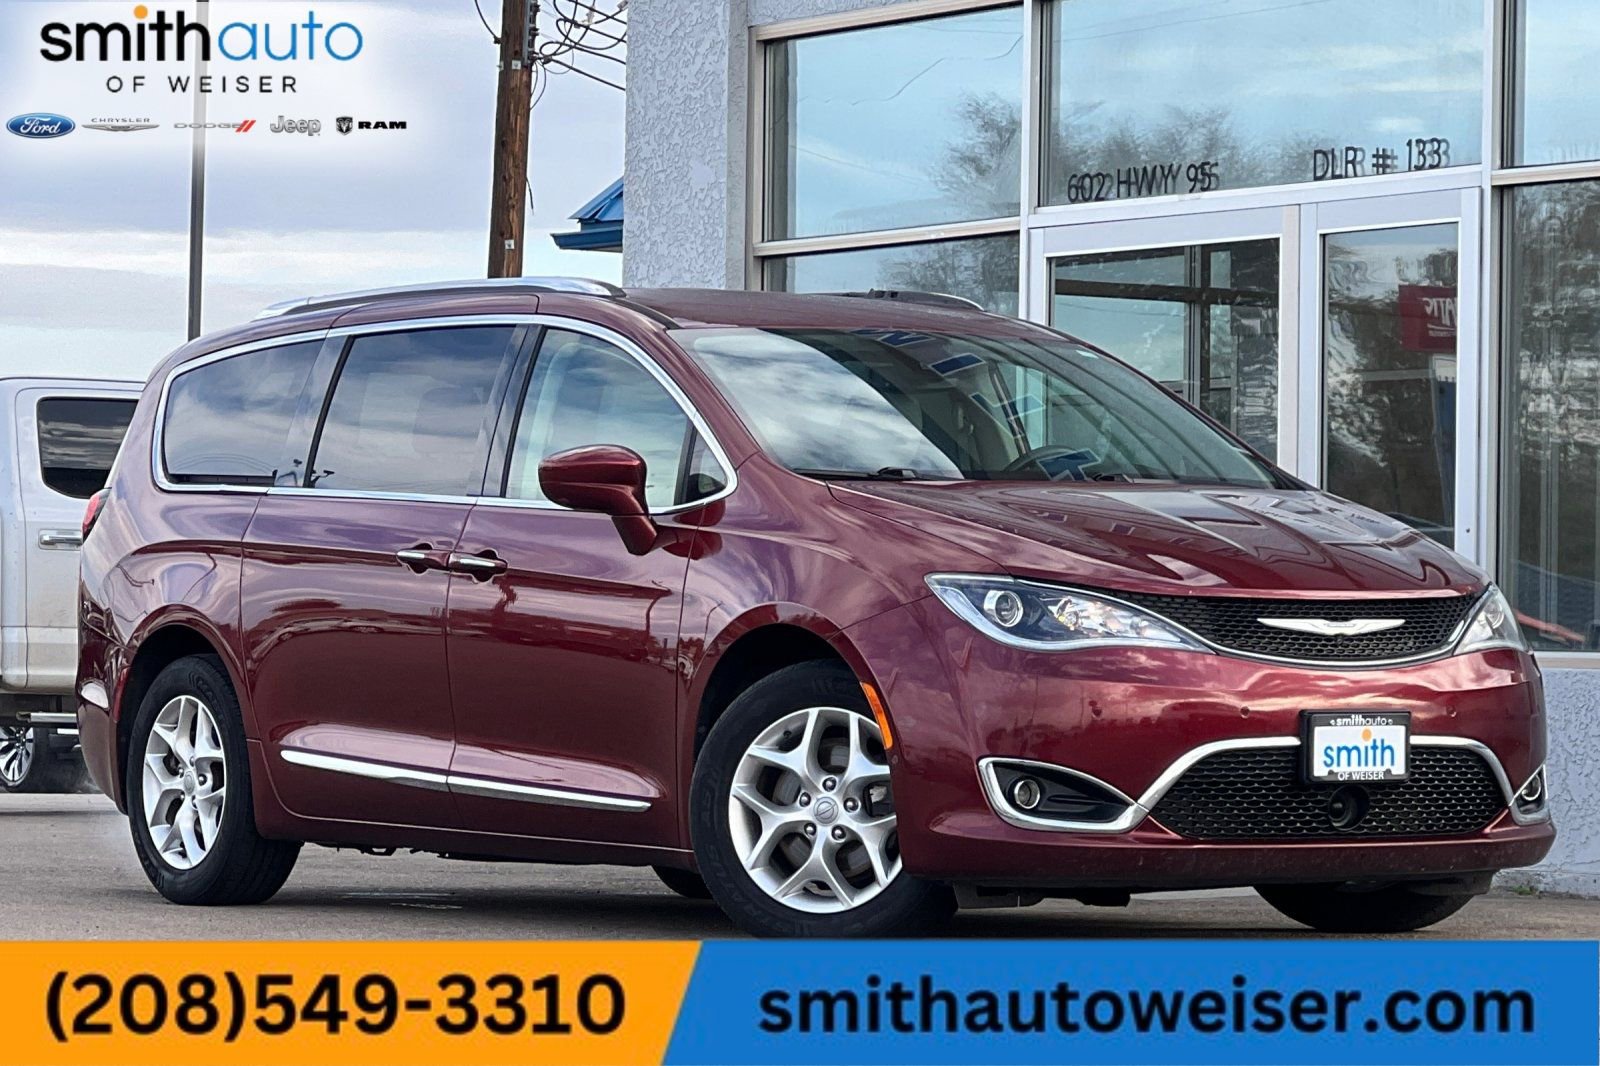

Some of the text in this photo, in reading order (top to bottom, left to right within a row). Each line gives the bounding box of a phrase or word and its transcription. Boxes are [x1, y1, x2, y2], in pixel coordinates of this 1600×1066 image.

[1336, 714, 1387, 726] smithauto
[1323, 728, 1395, 768] smith
[1337, 771, 1384, 781] OF WEISER
